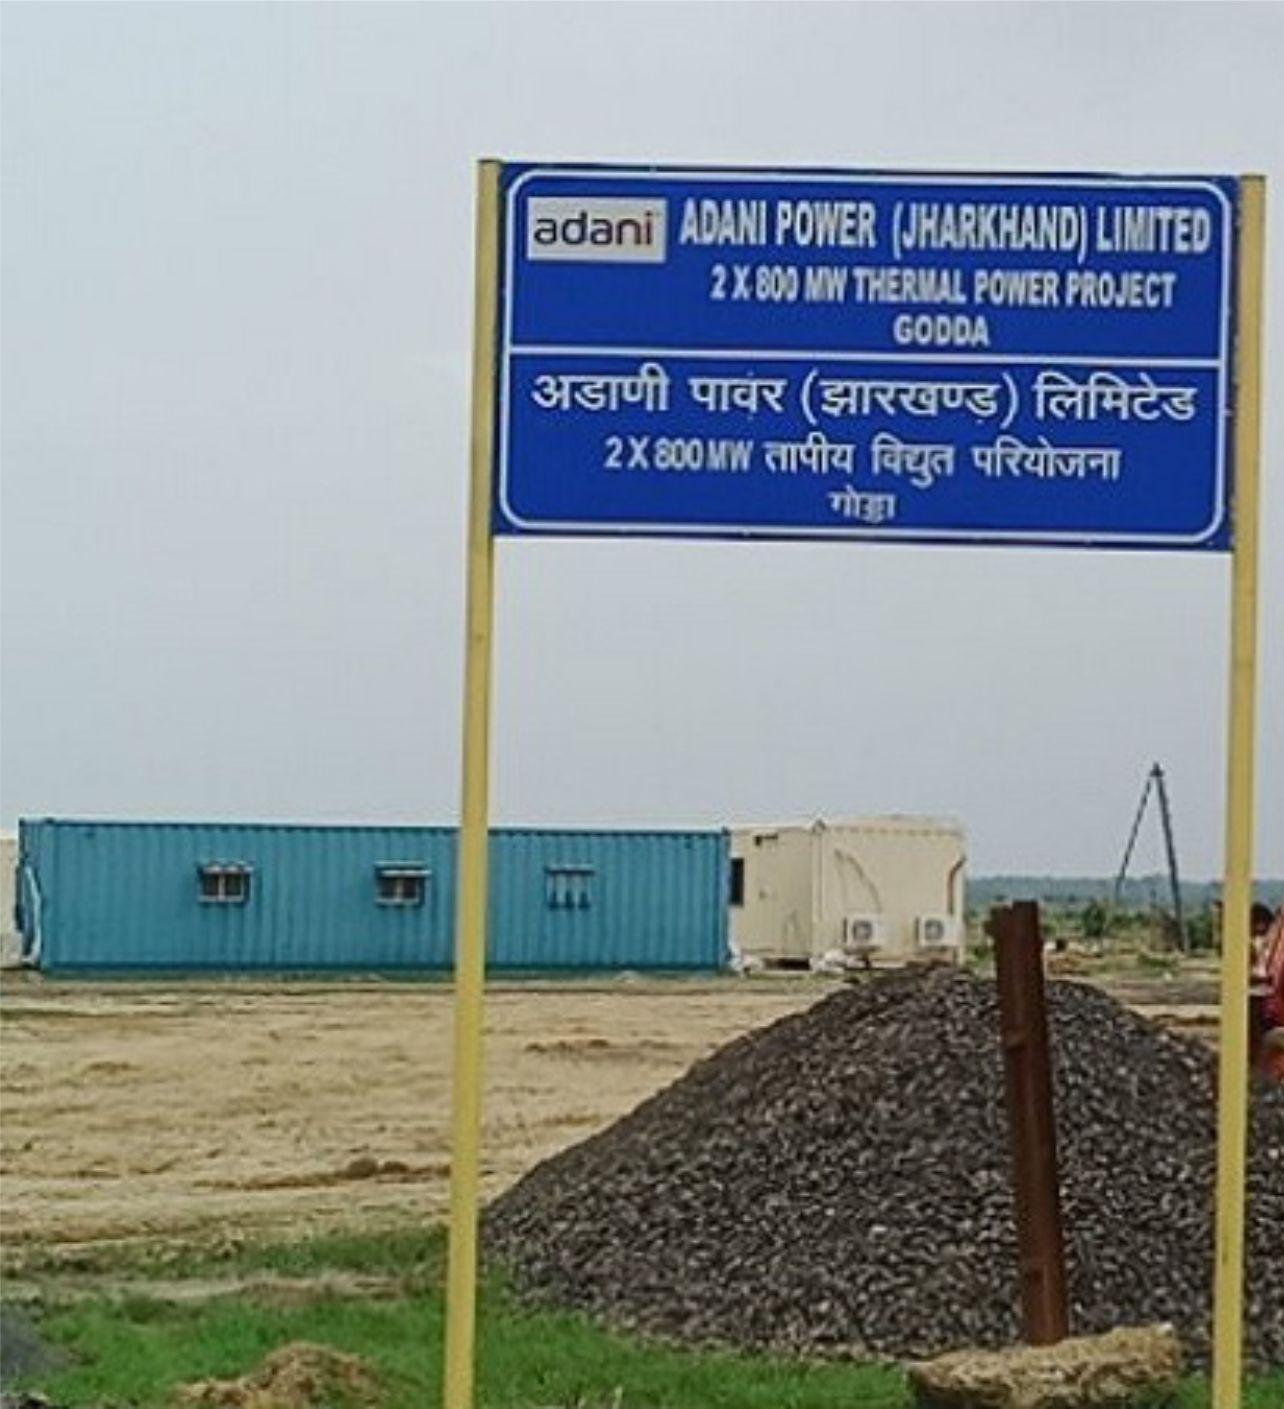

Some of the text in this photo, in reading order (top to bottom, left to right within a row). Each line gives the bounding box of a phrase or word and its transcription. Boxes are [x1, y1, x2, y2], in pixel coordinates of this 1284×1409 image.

[533, 210, 654, 245] adani
[678, 198, 1211, 265] ADANI POWER (JHARKHAND) LIMITED
[710, 264, 1176, 307] 2 X 800 MW THERMAL POWER PROJECT
[893, 315, 990, 347] GODDA
[531, 362, 671, 412] अडाणी
[1031, 371, 1199, 422] लिमिटेड
[604, 436, 624, 470] 2
[627, 436, 650, 470] X
[764, 431, 857, 474] तापीय
[871, 431, 956, 490] विद्युत
[971, 434, 1122, 481] परियोजना
